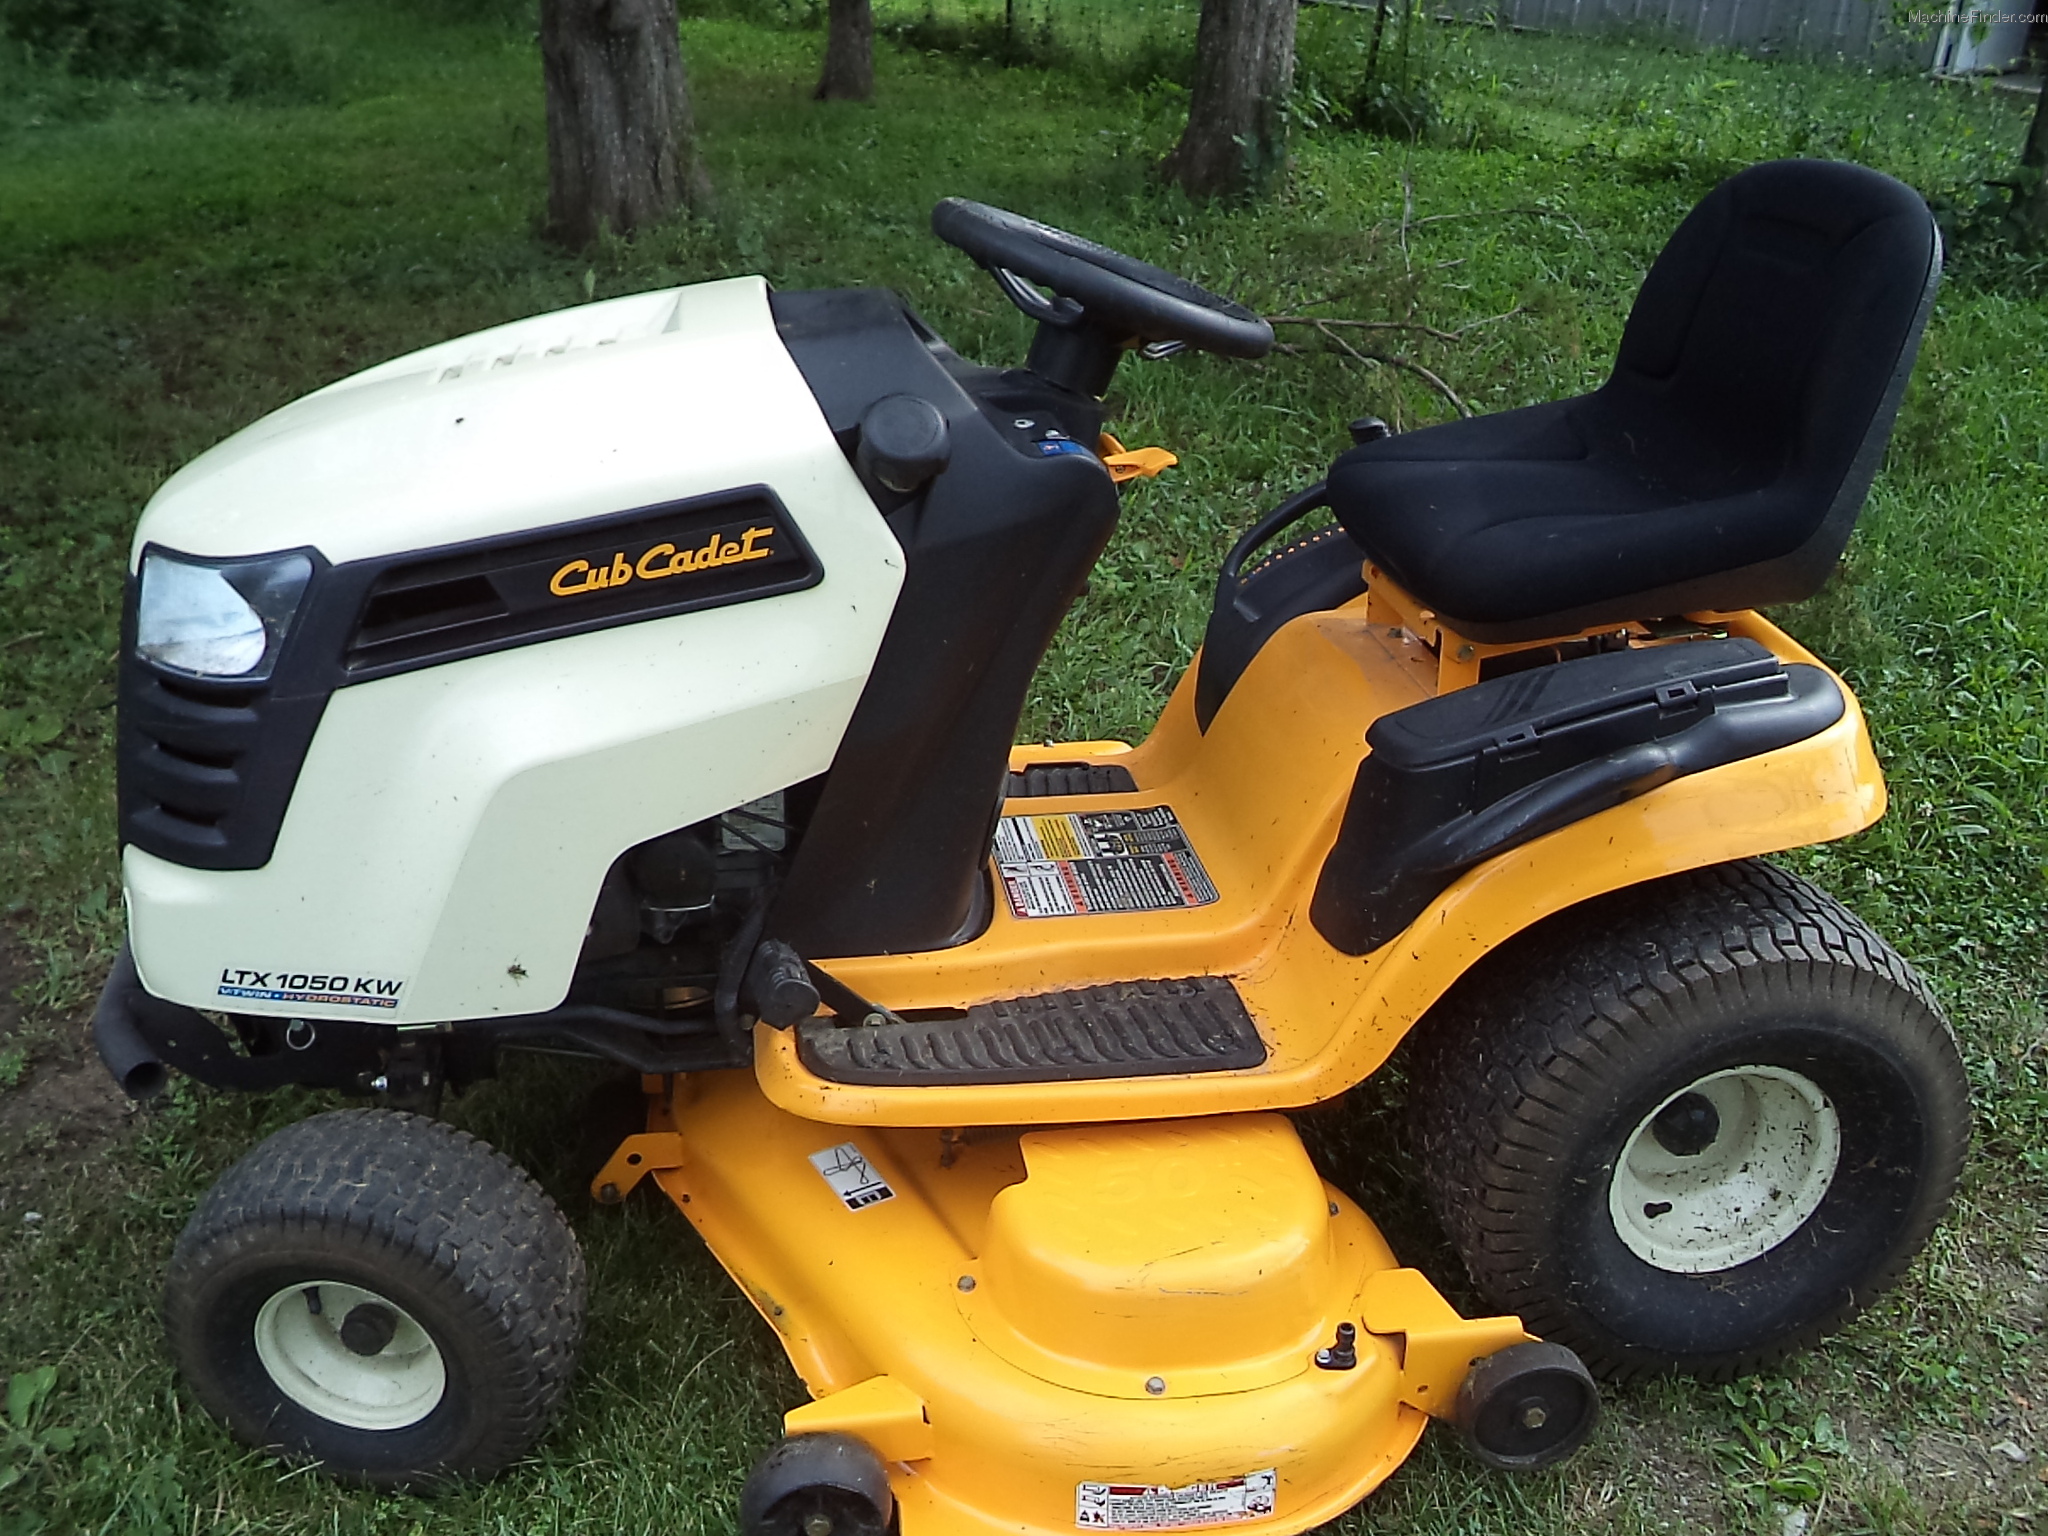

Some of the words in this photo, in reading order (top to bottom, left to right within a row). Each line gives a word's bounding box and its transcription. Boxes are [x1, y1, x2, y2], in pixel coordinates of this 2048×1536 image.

[549, 552, 633, 597] Cub
[636, 527, 774, 580] Cadet
[221, 968, 272, 988] LTX
[276, 973, 349, 992] 1050
[353, 977, 404, 996] KW
[281, 992, 397, 1008] HYDROSTATIC
